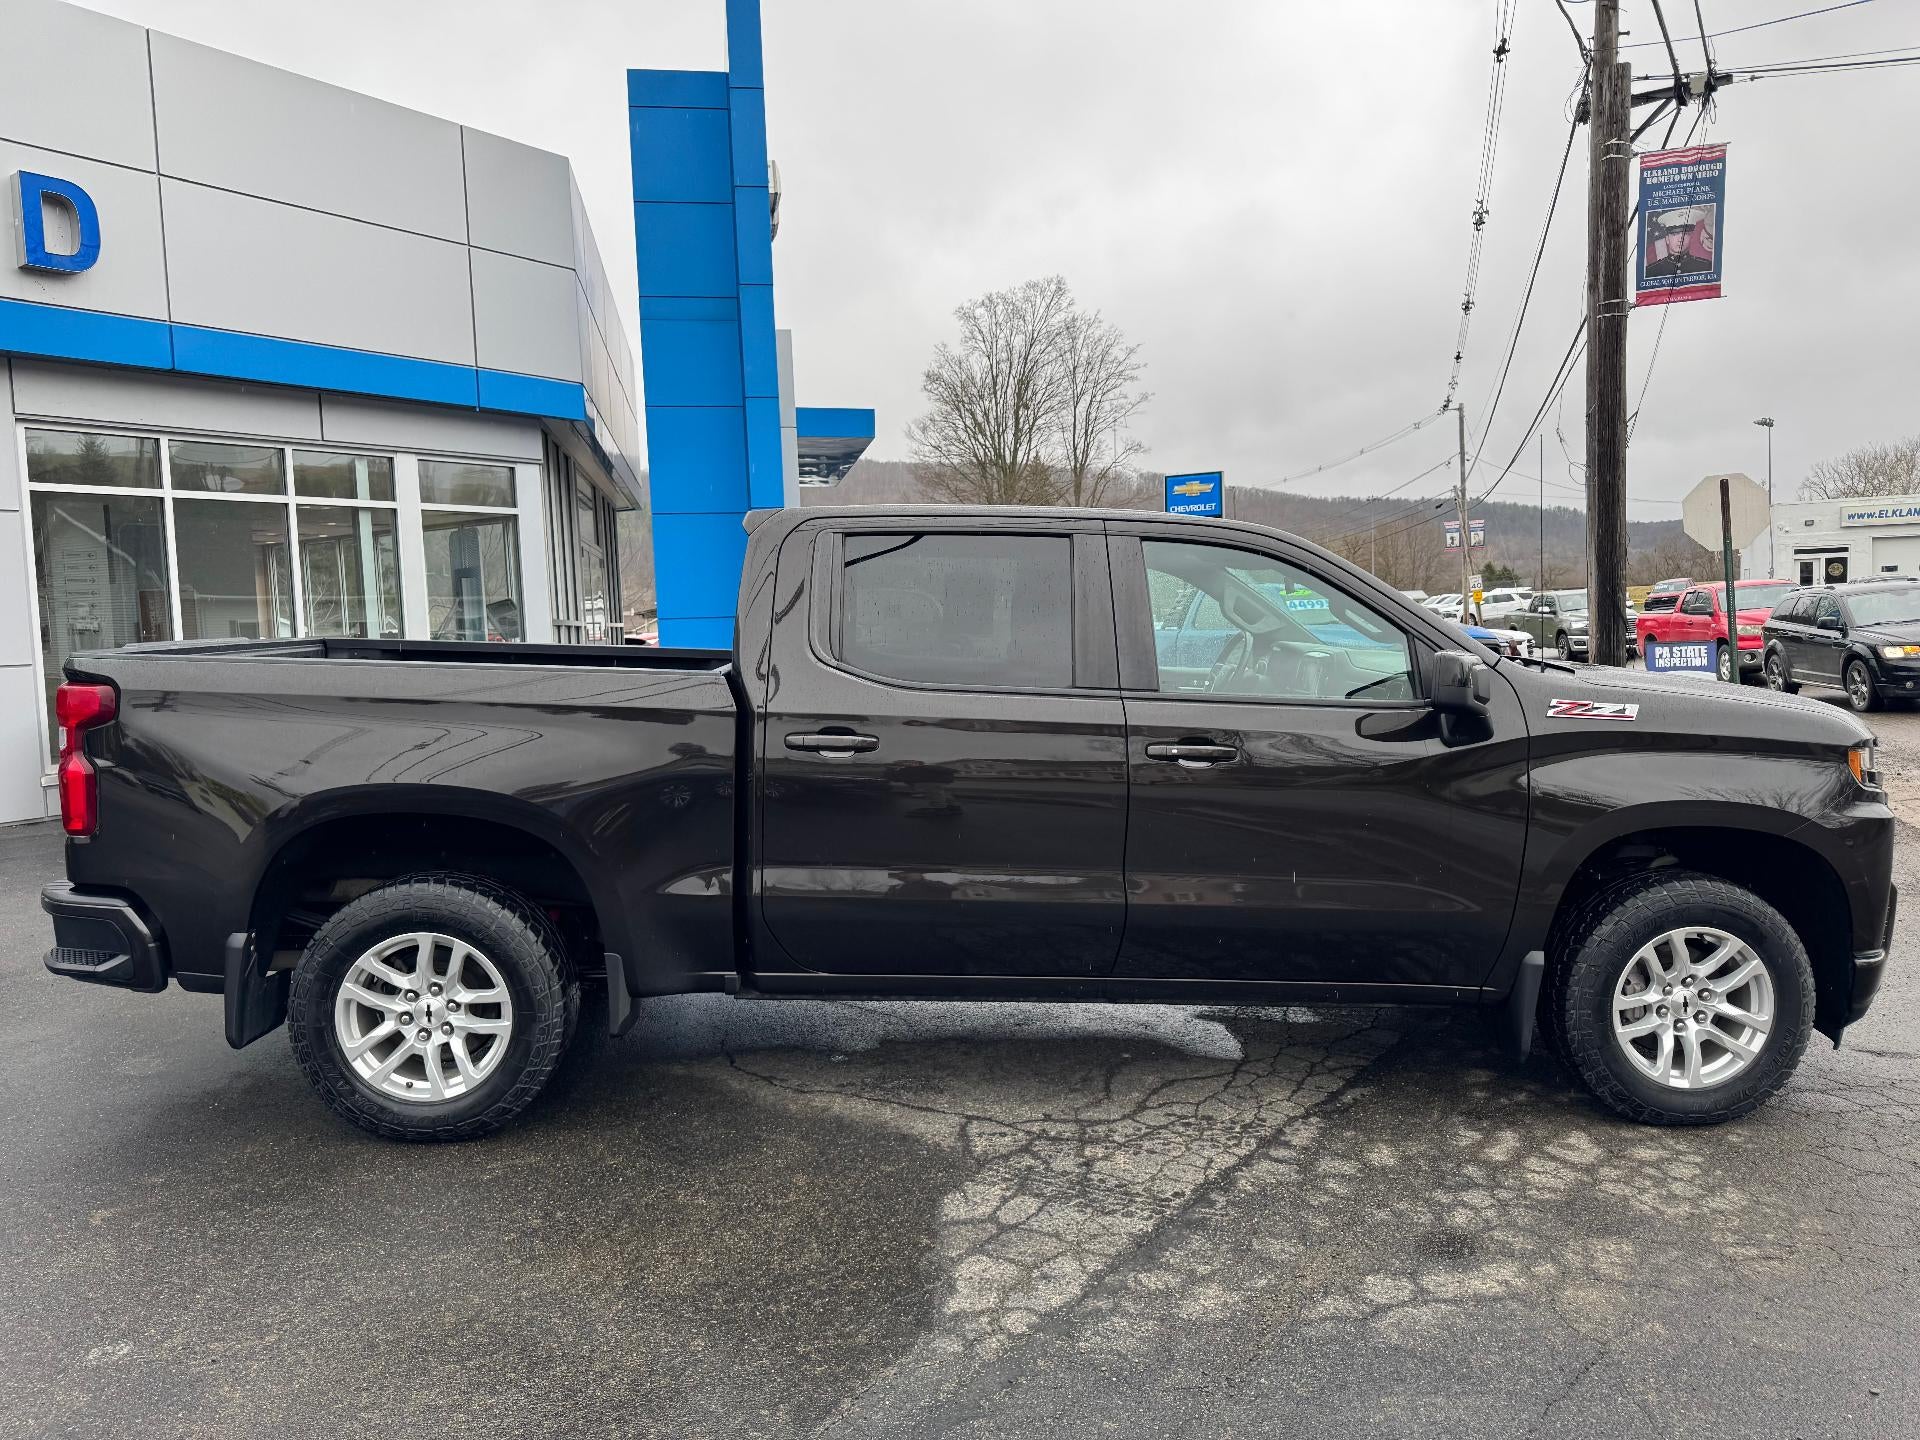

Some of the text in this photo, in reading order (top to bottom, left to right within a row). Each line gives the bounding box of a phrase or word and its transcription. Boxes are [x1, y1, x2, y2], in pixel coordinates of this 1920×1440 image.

[1643, 162, 1723, 178] ELKLAND BOROUGH
[1646, 172, 1693, 185] HOMETOWN
[1652, 185, 1712, 198] MICHAEL PLANK
[1662, 196, 1689, 205] MARINE
[17, 169, 101, 272] D
[1169, 502, 1217, 513] CHEVROLET
[1654, 645, 1708, 658] PA STATE
[1655, 656, 1708, 668] INSPECTION
[1546, 699, 1640, 720] Z71
